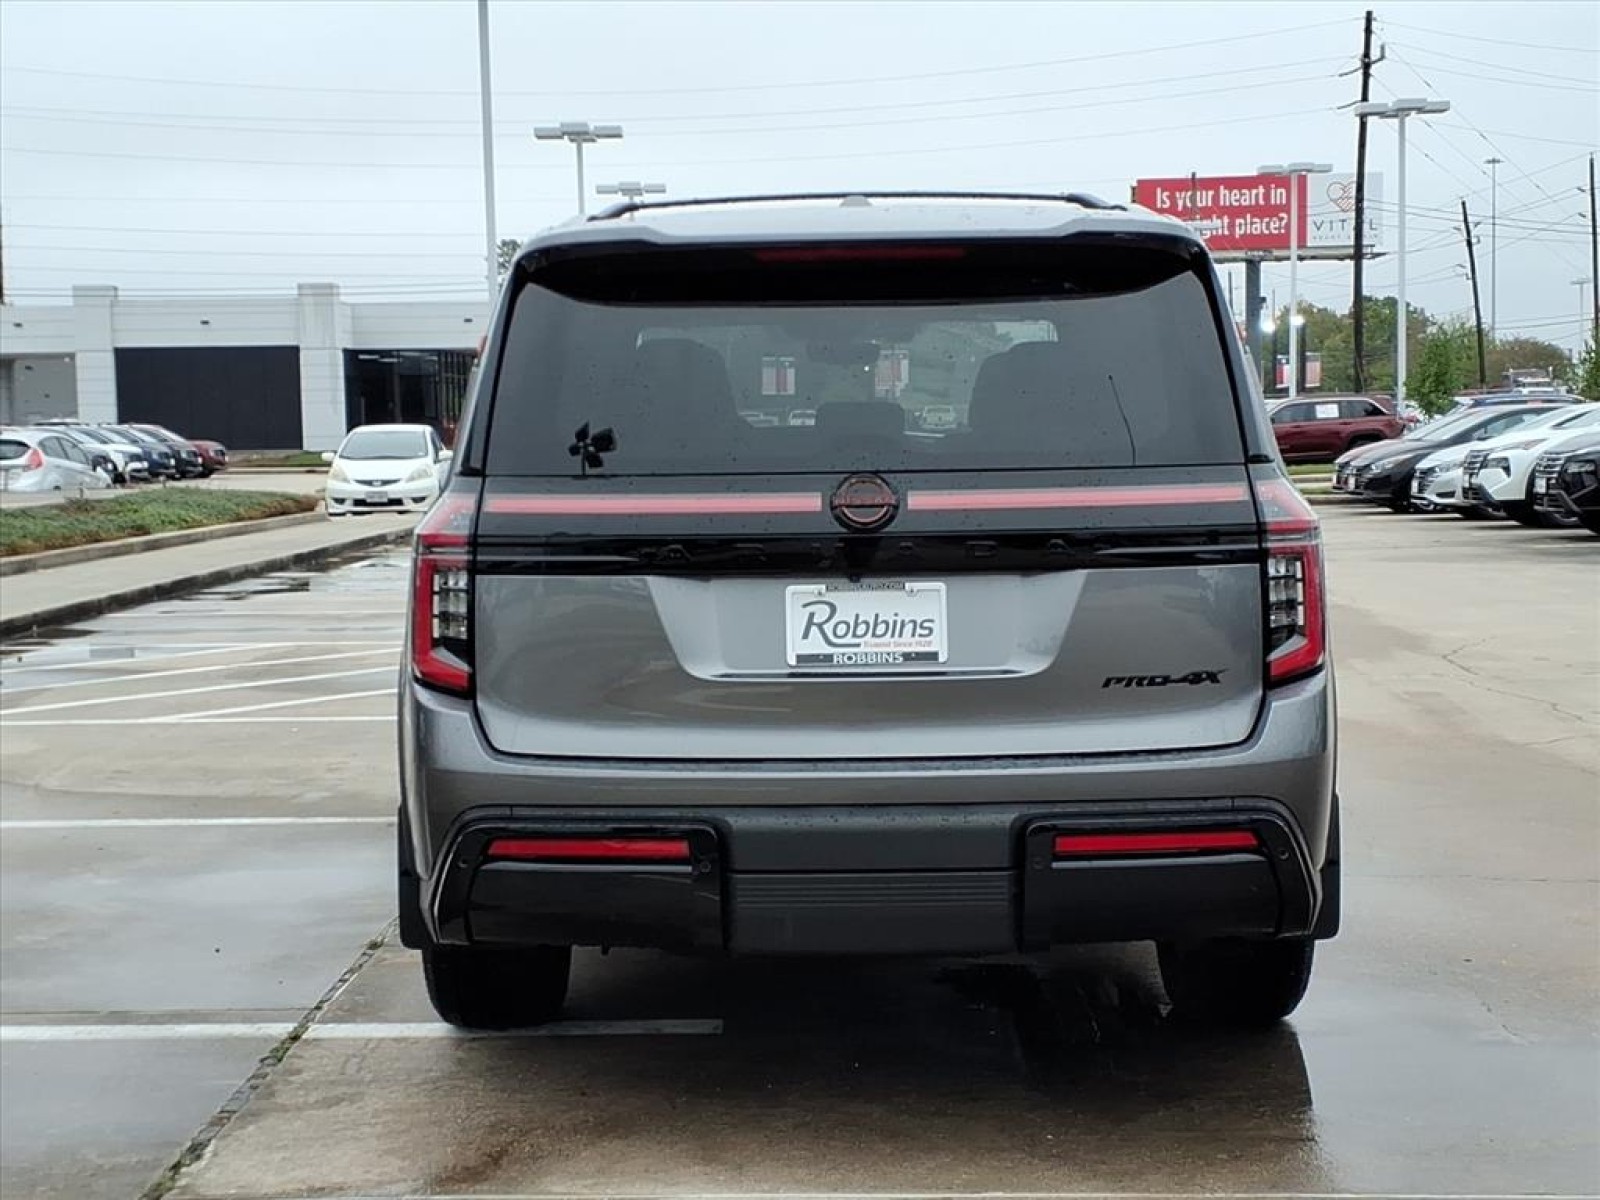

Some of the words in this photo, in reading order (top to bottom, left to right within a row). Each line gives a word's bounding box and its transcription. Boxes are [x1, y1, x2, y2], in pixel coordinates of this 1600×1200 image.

[1156, 187, 1171, 209] Is
[1219, 184, 1265, 206] heart
[1270, 183, 1287, 205] in
[1235, 213, 1288, 238] place?
[1313, 218, 1378, 232] VITL
[801, 600, 935, 648] Robbins
[833, 652, 904, 665] ROBBINS
[1101, 668, 1230, 688] PRO-4X
